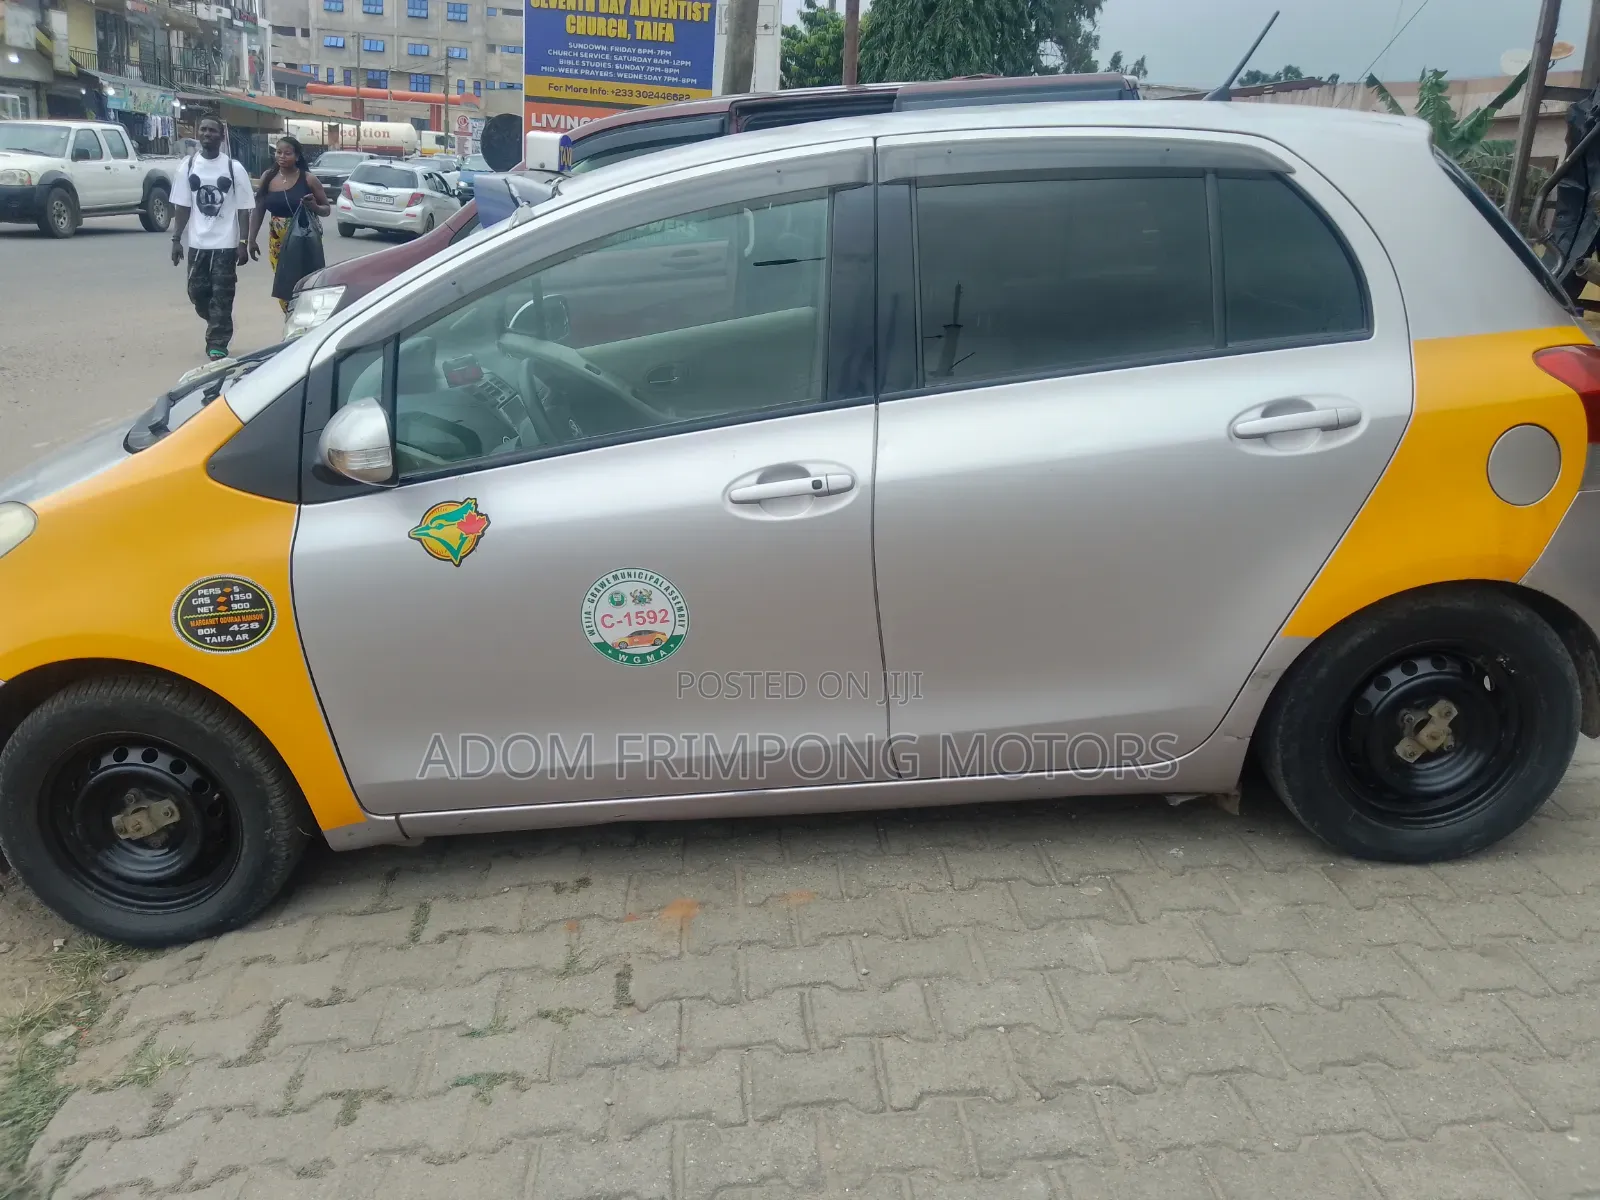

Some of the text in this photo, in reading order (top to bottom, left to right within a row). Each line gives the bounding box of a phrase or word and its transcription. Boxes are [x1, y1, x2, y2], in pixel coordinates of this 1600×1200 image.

[599, 0, 627, 15] DAY
[629, 0, 712, 22] ADVENTIST
[565, 14, 675, 43] CHURCH, TAIFA
[568, 42, 609, 52] SUNDOWN:
[610, 45, 637, 54] FRIDAY
[547, 48, 692, 67] CHURCH SERVICE: SATURDAY 8AM-12PM
[559, 58, 680, 74] BIBLE STUDIES: SUNDAY 7PM-8PM
[540, 65, 697, 84] MID-WEEK PRAYERS: WEDNESDAY 7PM-8PM
[548, 82, 563, 92] For
[565, 84, 588, 94] More
[589, 87, 609, 96] Info:
[610, 88, 634, 98] +233
[531, 112, 600, 130] LIVING
[560, 145, 572, 166] TAXI
[611, 571, 664, 588] MUNICIPAL
[191, 592, 253, 605] GRS 1350
[197, 587, 222, 596] PERS
[197, 602, 250, 614] NET 900
[189, 617, 219, 628] MARGARET
[600, 608, 670, 629] C-1592
[197, 622, 260, 636] BOX 428
[205, 633, 249, 644] TAIFA AR
